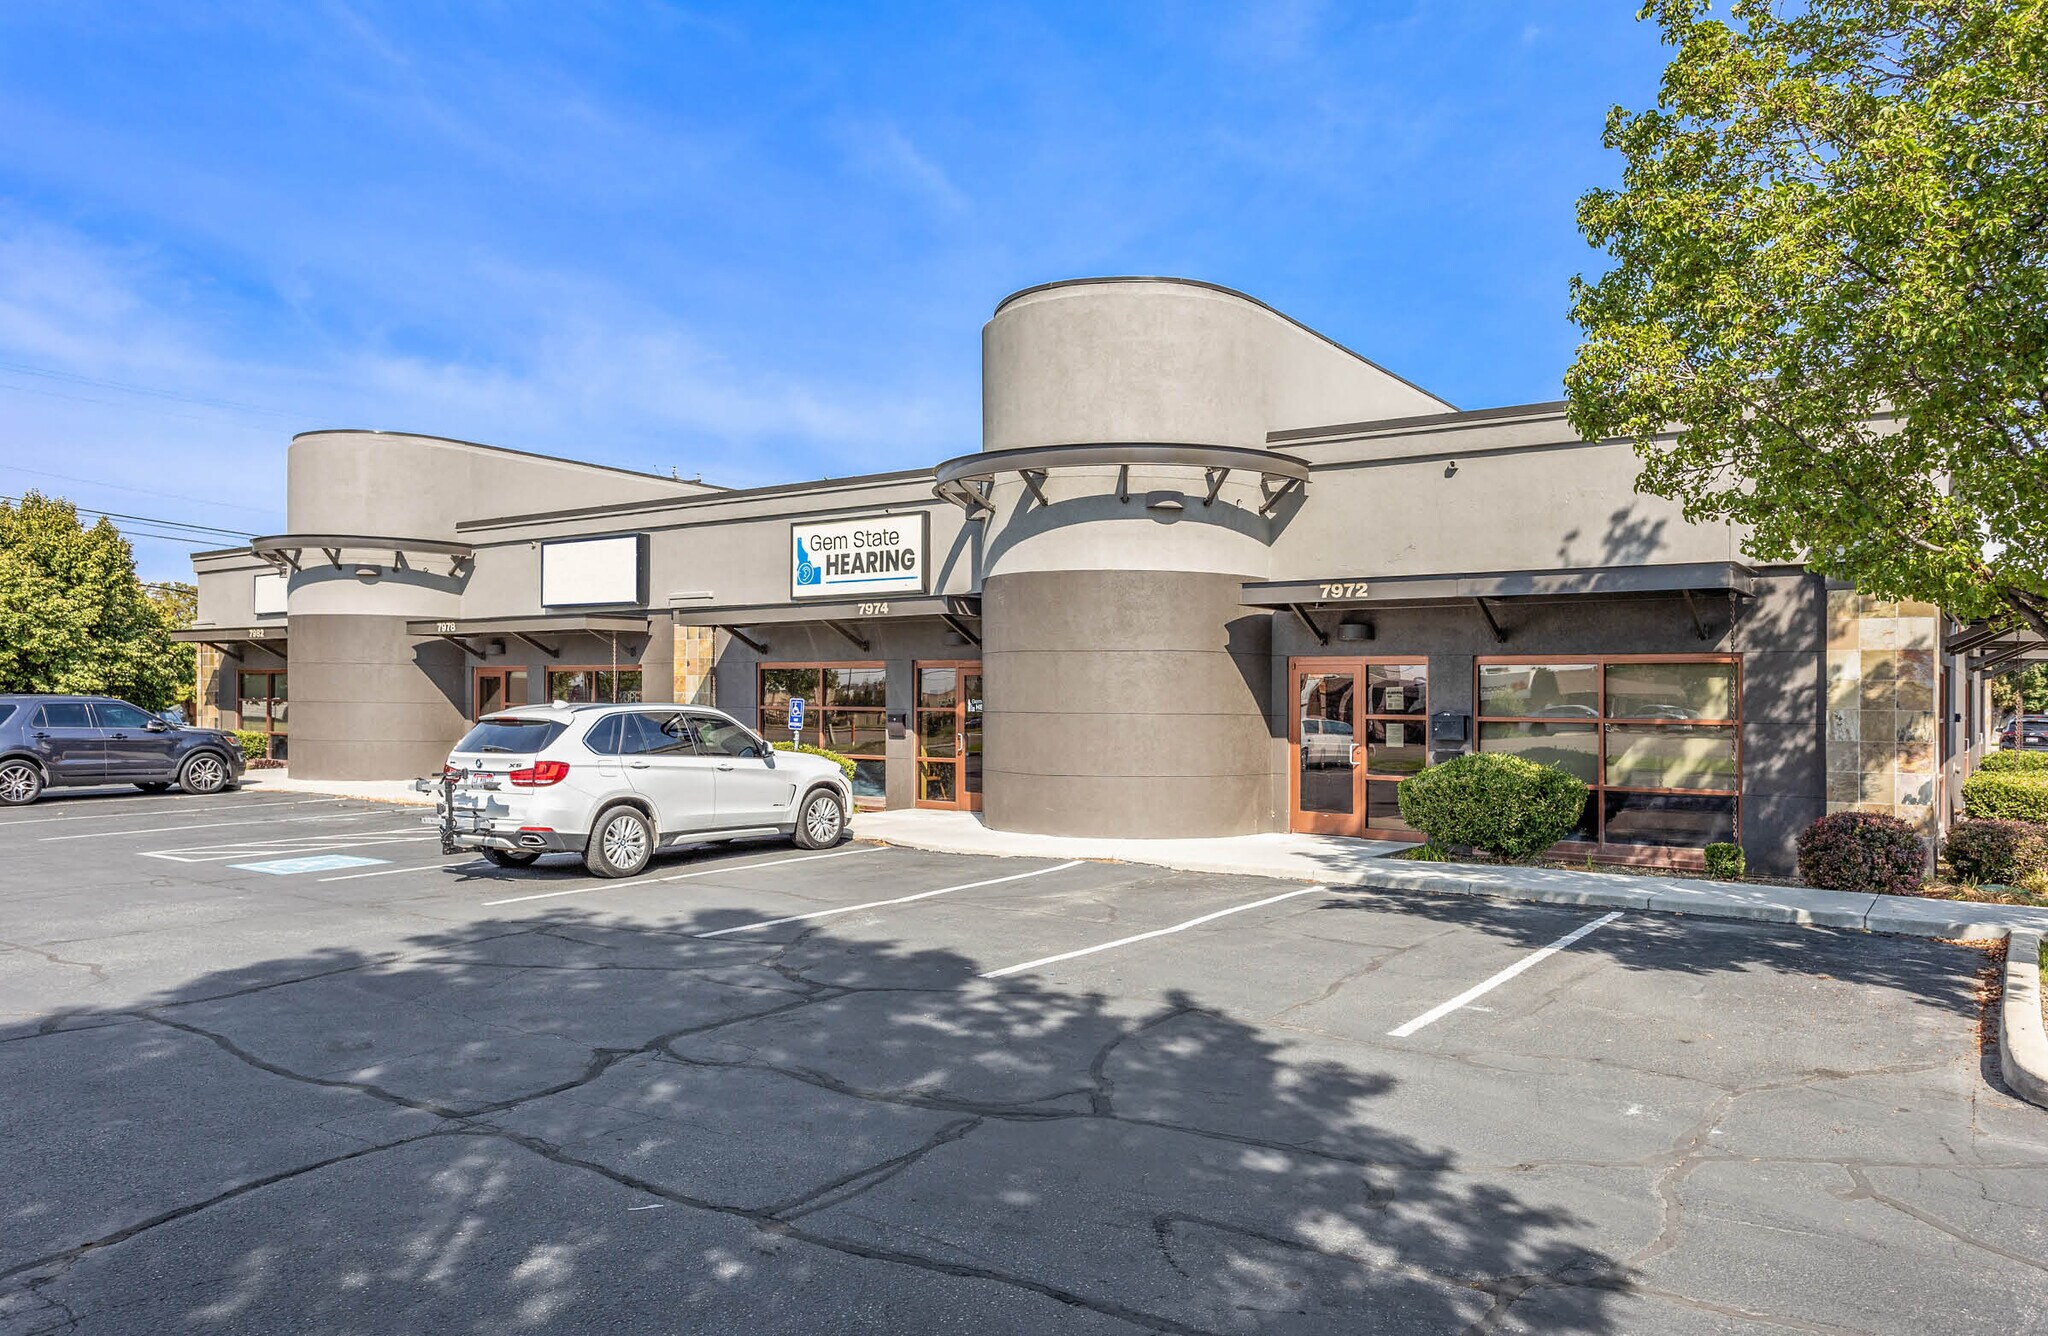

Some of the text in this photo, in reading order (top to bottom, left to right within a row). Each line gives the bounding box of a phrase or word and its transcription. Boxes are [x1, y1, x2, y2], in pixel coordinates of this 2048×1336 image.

[810, 528, 900, 552] Gem State
[825, 548, 916, 576] HEARING
[1319, 582, 1369, 599] 7972
[857, 602, 889, 615] 7974
[436, 622, 456, 632] 7978
